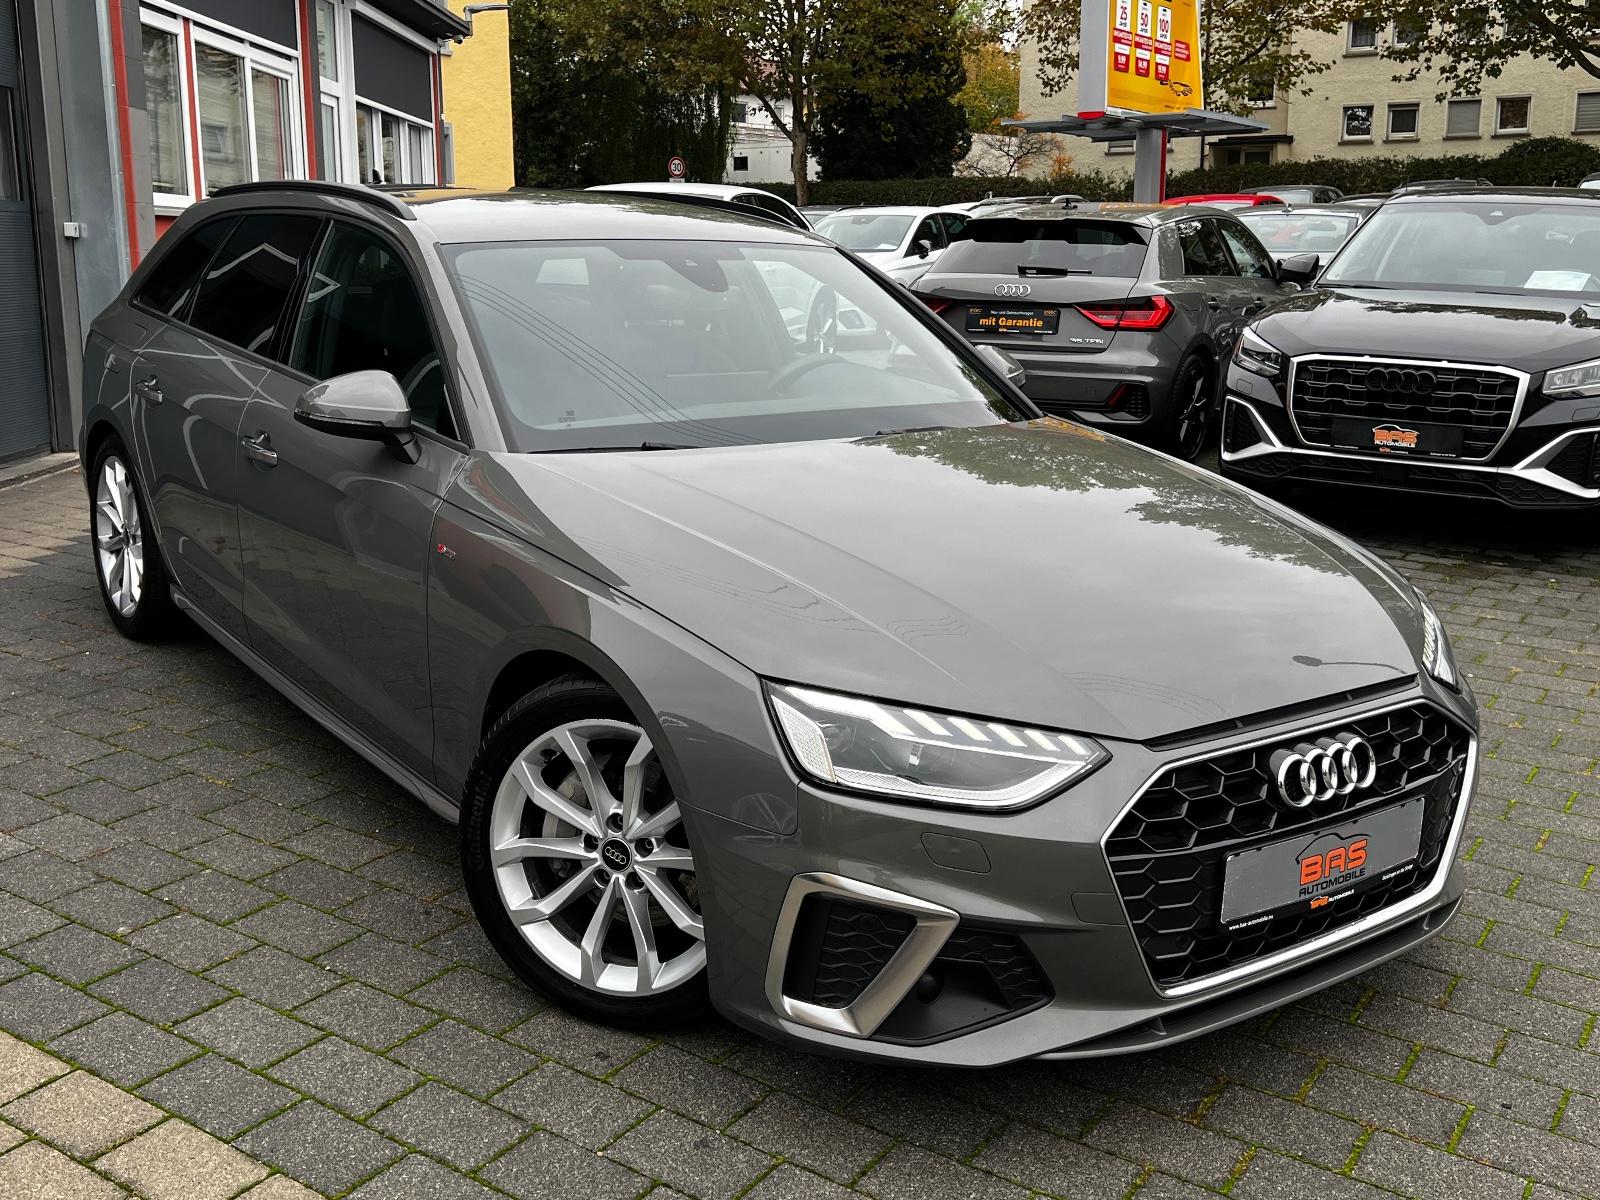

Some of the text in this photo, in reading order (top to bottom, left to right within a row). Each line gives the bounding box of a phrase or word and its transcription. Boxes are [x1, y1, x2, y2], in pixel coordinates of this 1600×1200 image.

[1120, 5, 1127, 21] 25
[1140, 12, 1149, 28] 50
[1159, 18, 1169, 33] 100
[672, 162, 682, 172] 30
[979, 317, 1044, 327] mit Garantie
[1374, 429, 1418, 443] BAS
[1374, 440, 1416, 448] AUTOMOBILE
[1300, 838, 1368, 886] BAS
[1298, 867, 1366, 898] AUTOMOBILE
